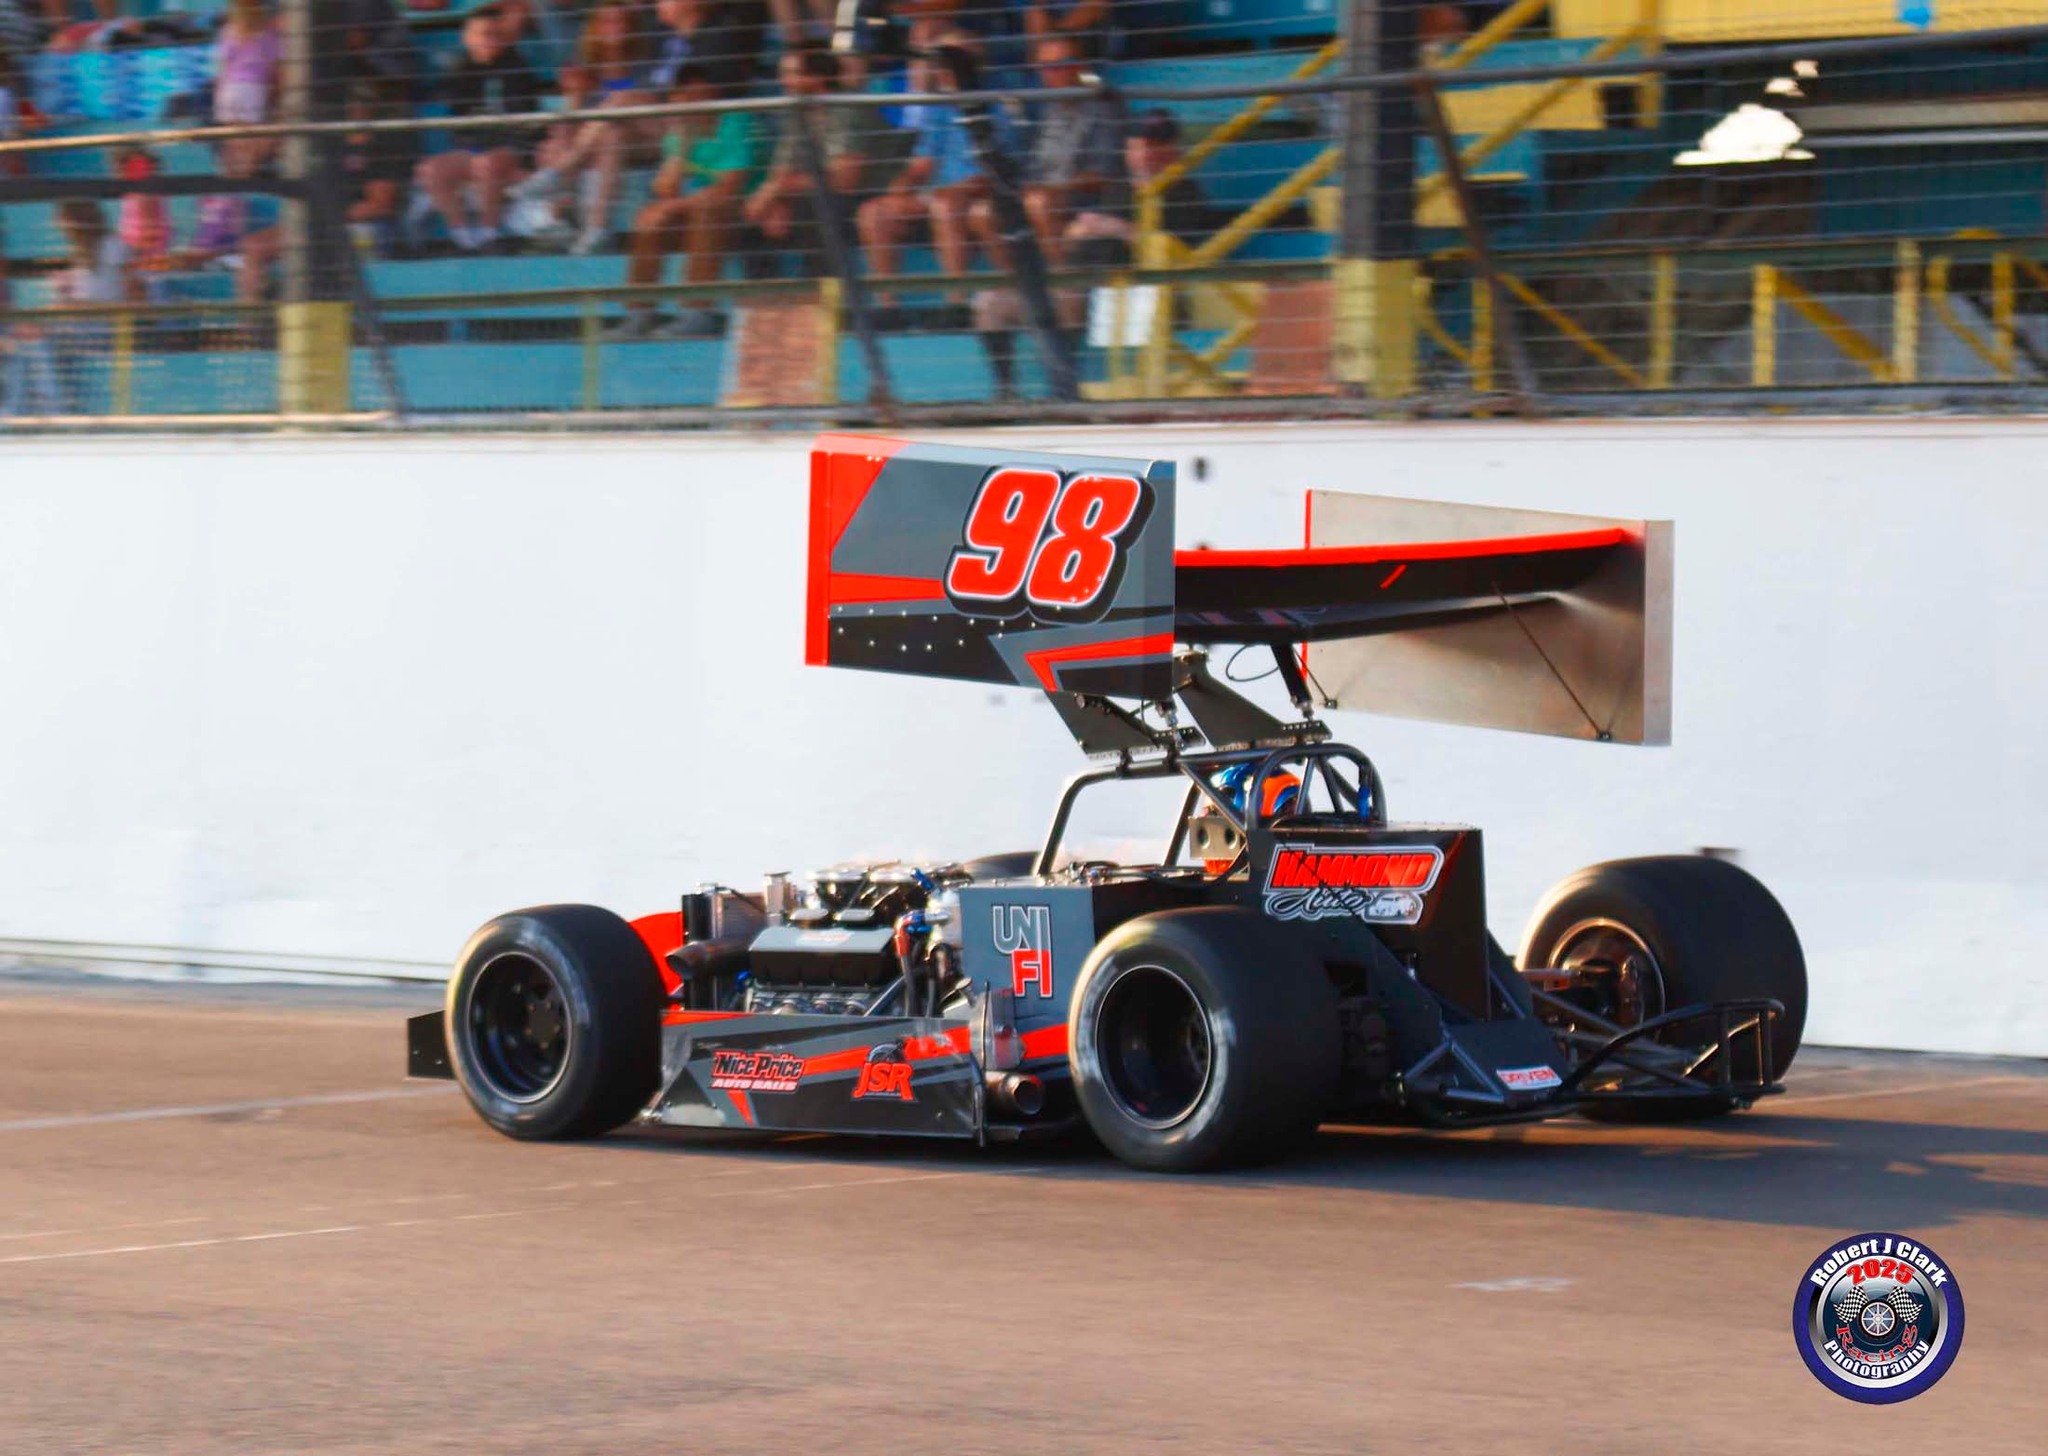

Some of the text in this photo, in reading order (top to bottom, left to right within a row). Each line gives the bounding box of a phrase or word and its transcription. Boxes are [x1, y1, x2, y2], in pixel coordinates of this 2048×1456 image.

[946, 465, 1143, 610] 98
[1271, 850, 1435, 888] HAMMOND
[1272, 887, 1370, 914] Auto
[716, 1054, 803, 1078] Nice Price
[852, 1062, 914, 1101] JSR
[711, 1079, 798, 1091] AUTO SALES
